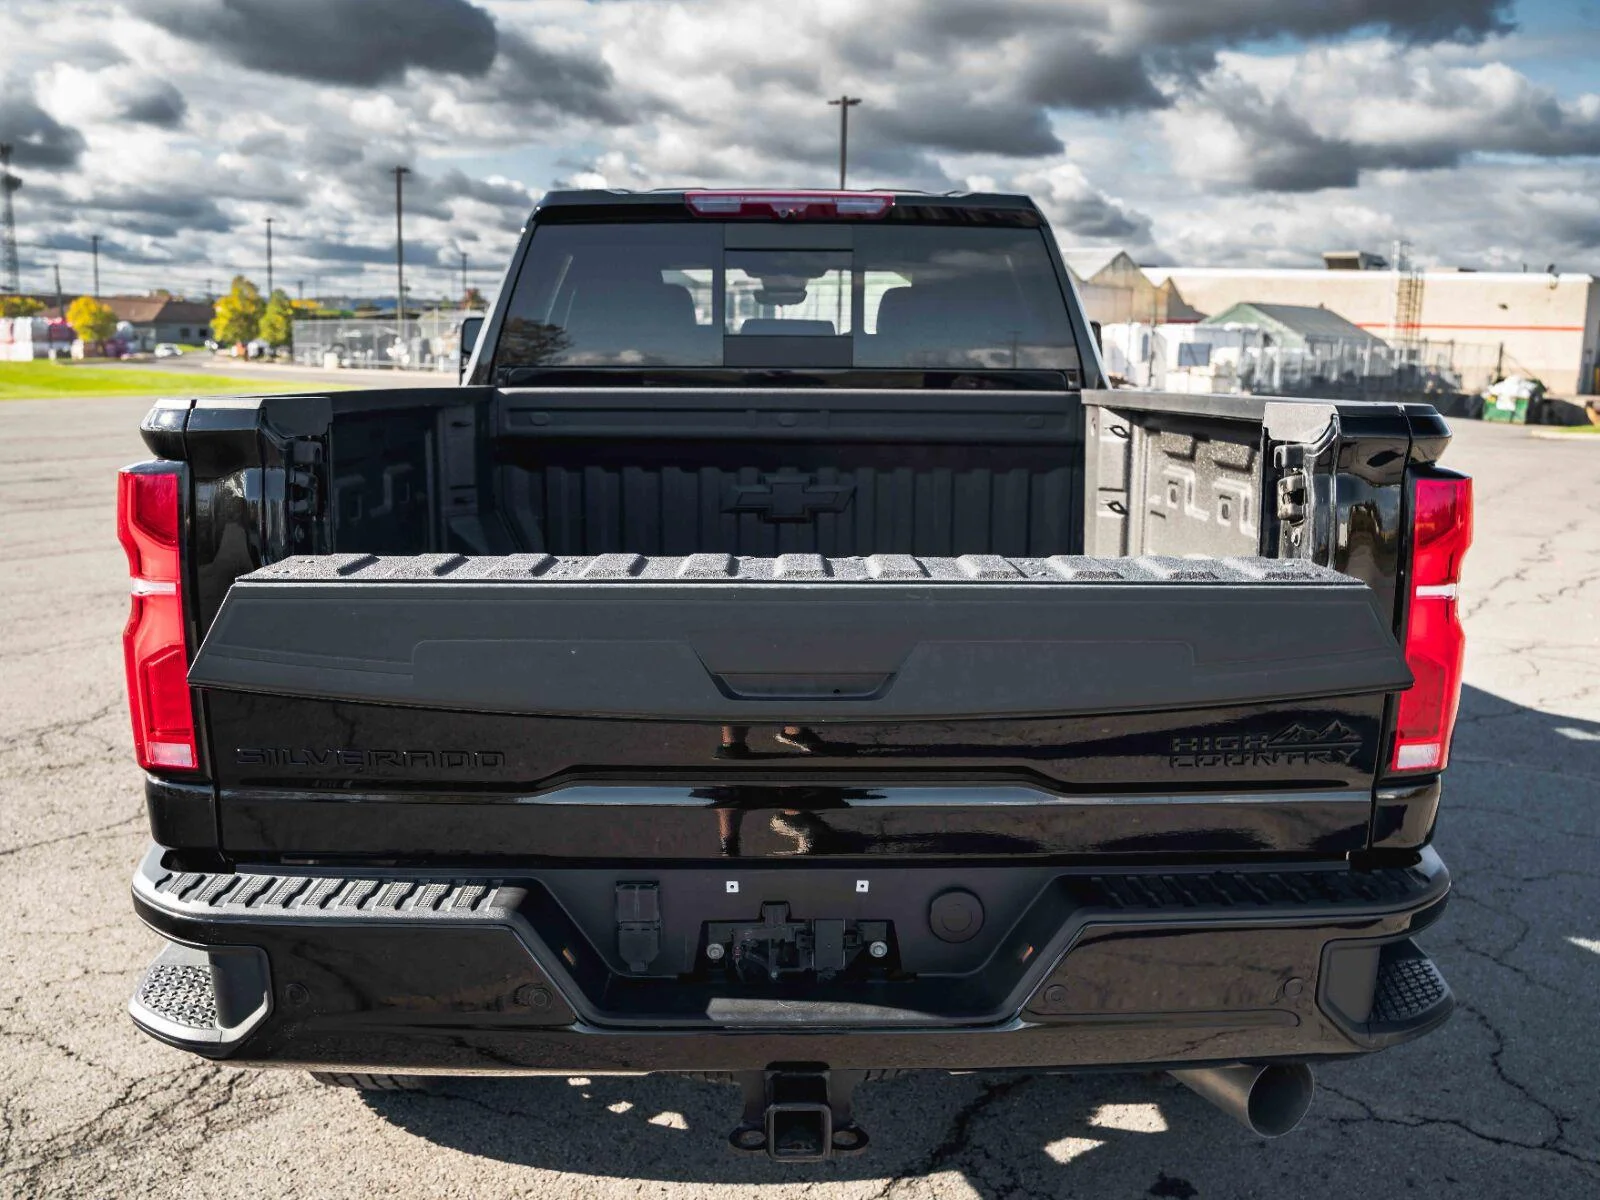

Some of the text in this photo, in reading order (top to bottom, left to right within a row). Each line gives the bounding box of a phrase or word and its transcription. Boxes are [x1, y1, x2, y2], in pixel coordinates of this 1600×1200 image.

[1171, 735, 1268, 751] HIGH
[236, 748, 505, 767] SILVERADO
[1169, 750, 1360, 767] COUNTRY
